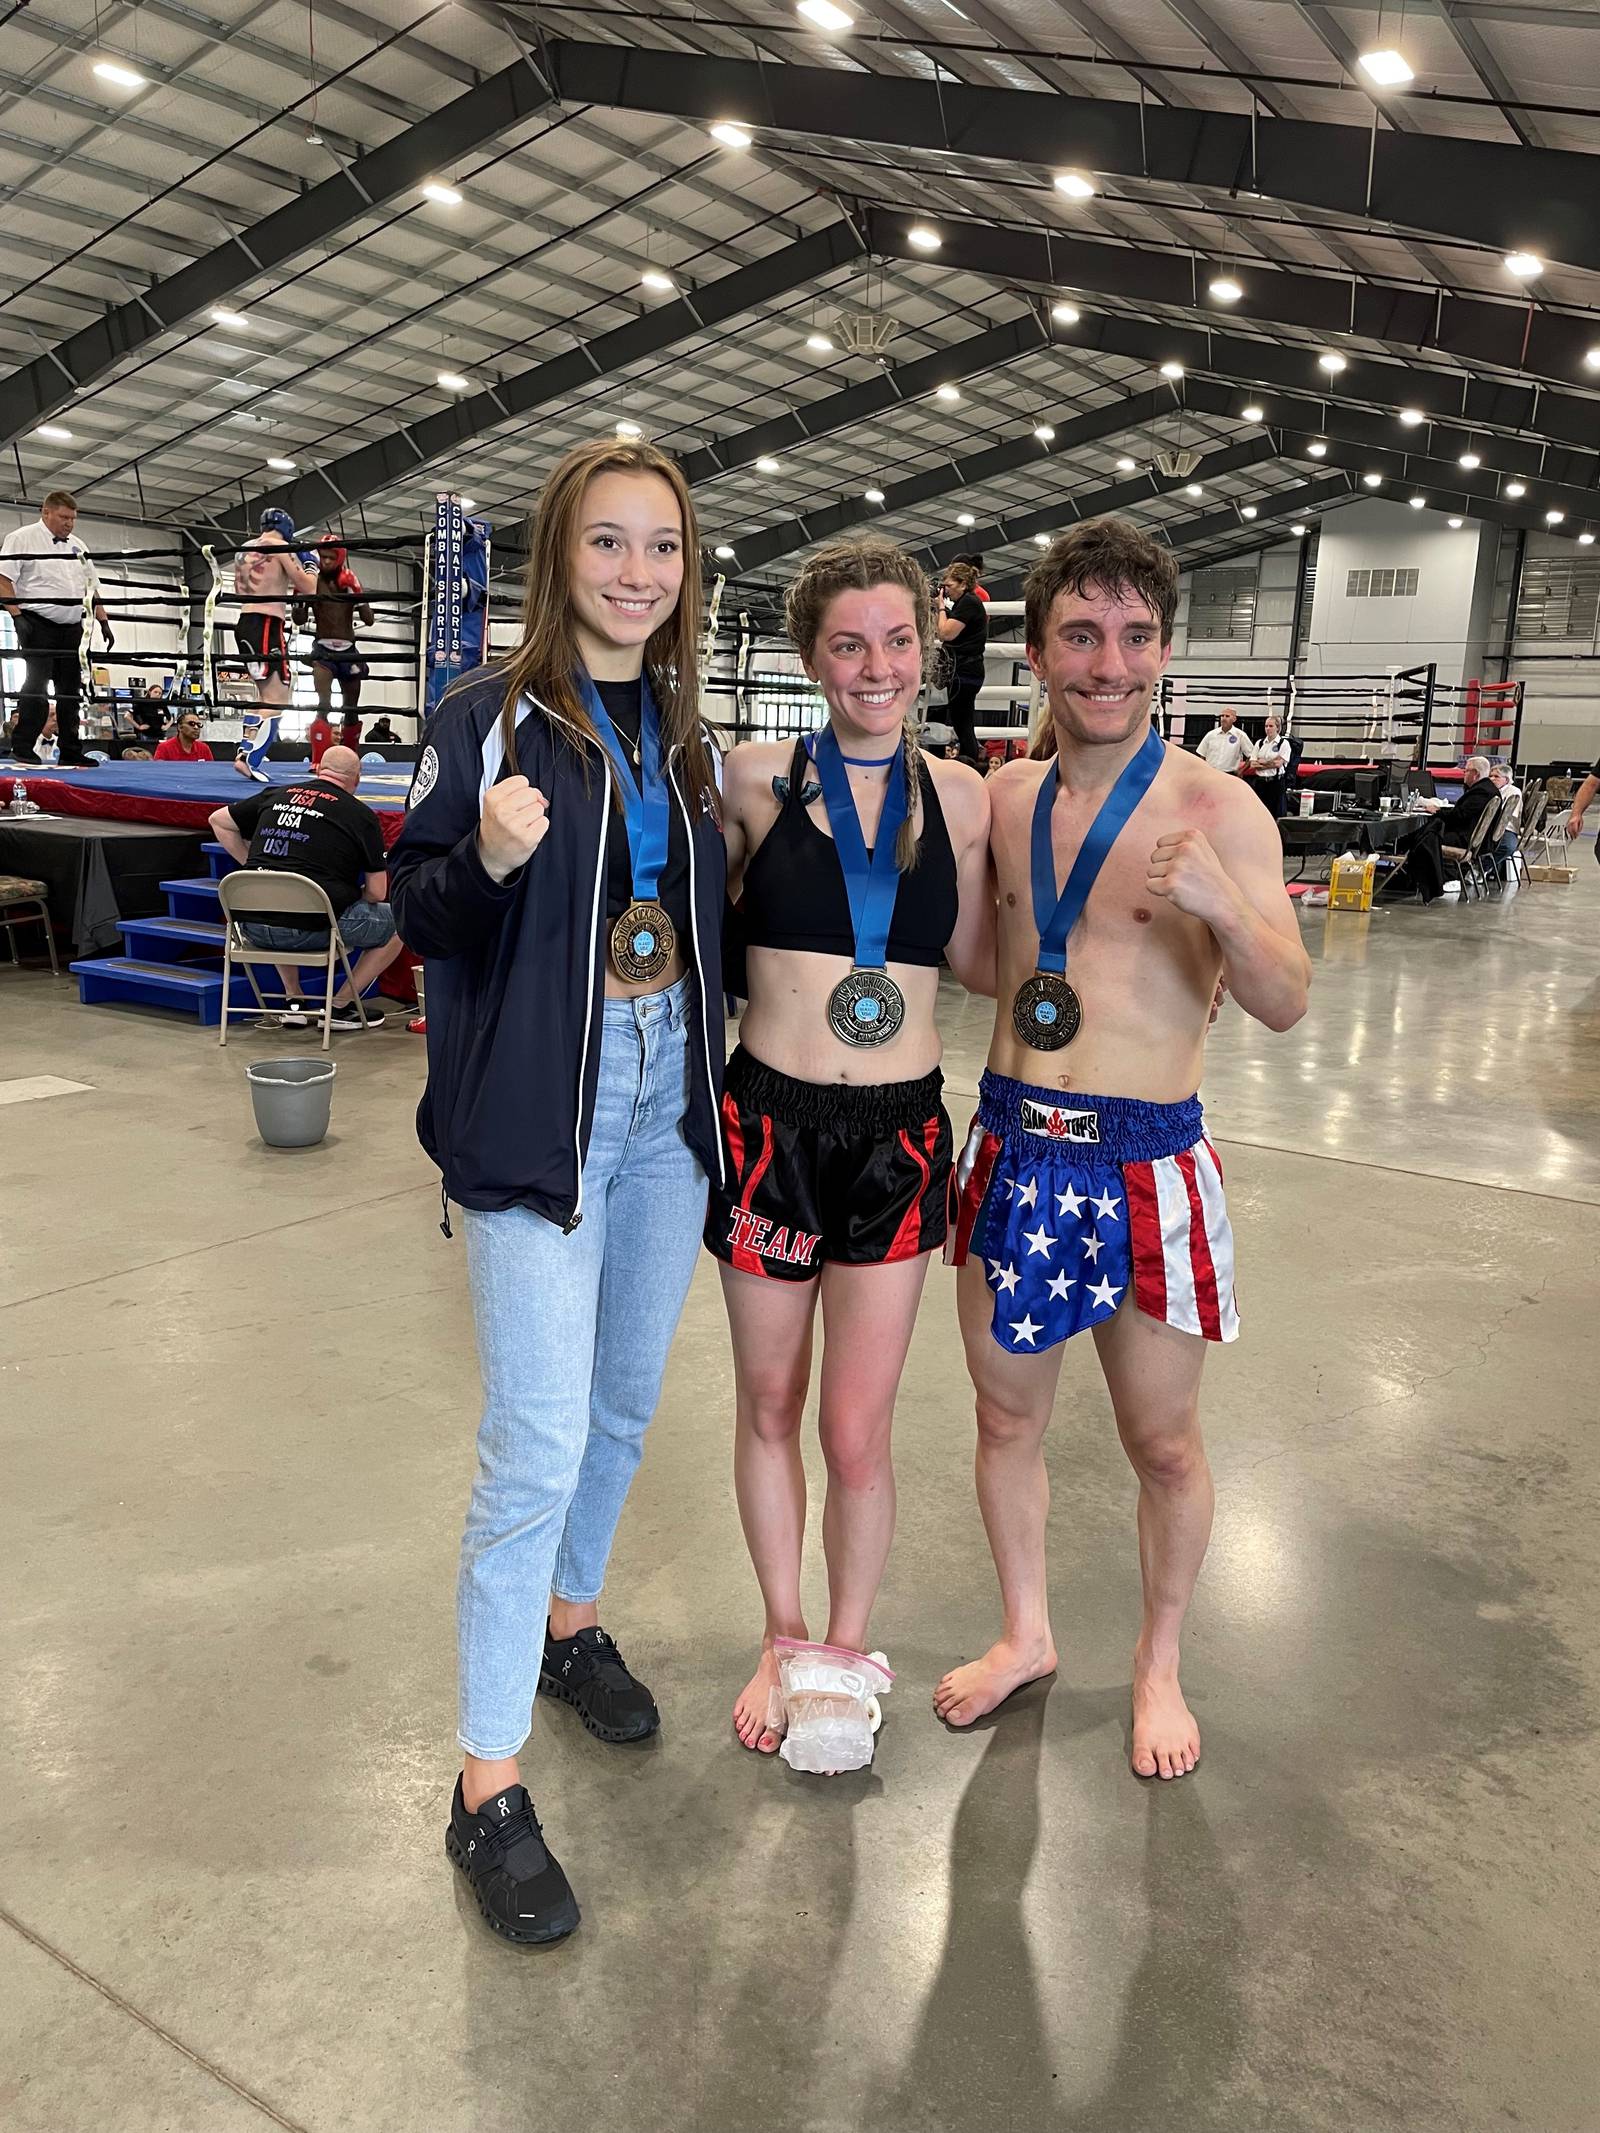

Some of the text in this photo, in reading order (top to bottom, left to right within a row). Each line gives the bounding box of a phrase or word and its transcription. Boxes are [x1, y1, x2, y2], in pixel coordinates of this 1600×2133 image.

[437, 505, 446, 576] COMBAT
[452, 506, 461, 577] COMBAT
[437, 580, 446, 649] SPORTS
[451, 581, 460, 650] SPORTS
[272, 803, 290, 811] WHO
[288, 805, 306, 813] ARE
[290, 794, 316, 807] USA
[274, 828, 290, 837] ARE
[277, 812, 302, 829] USA
[263, 838, 289, 856] USA
[726, 1205, 823, 1266] TEAM
